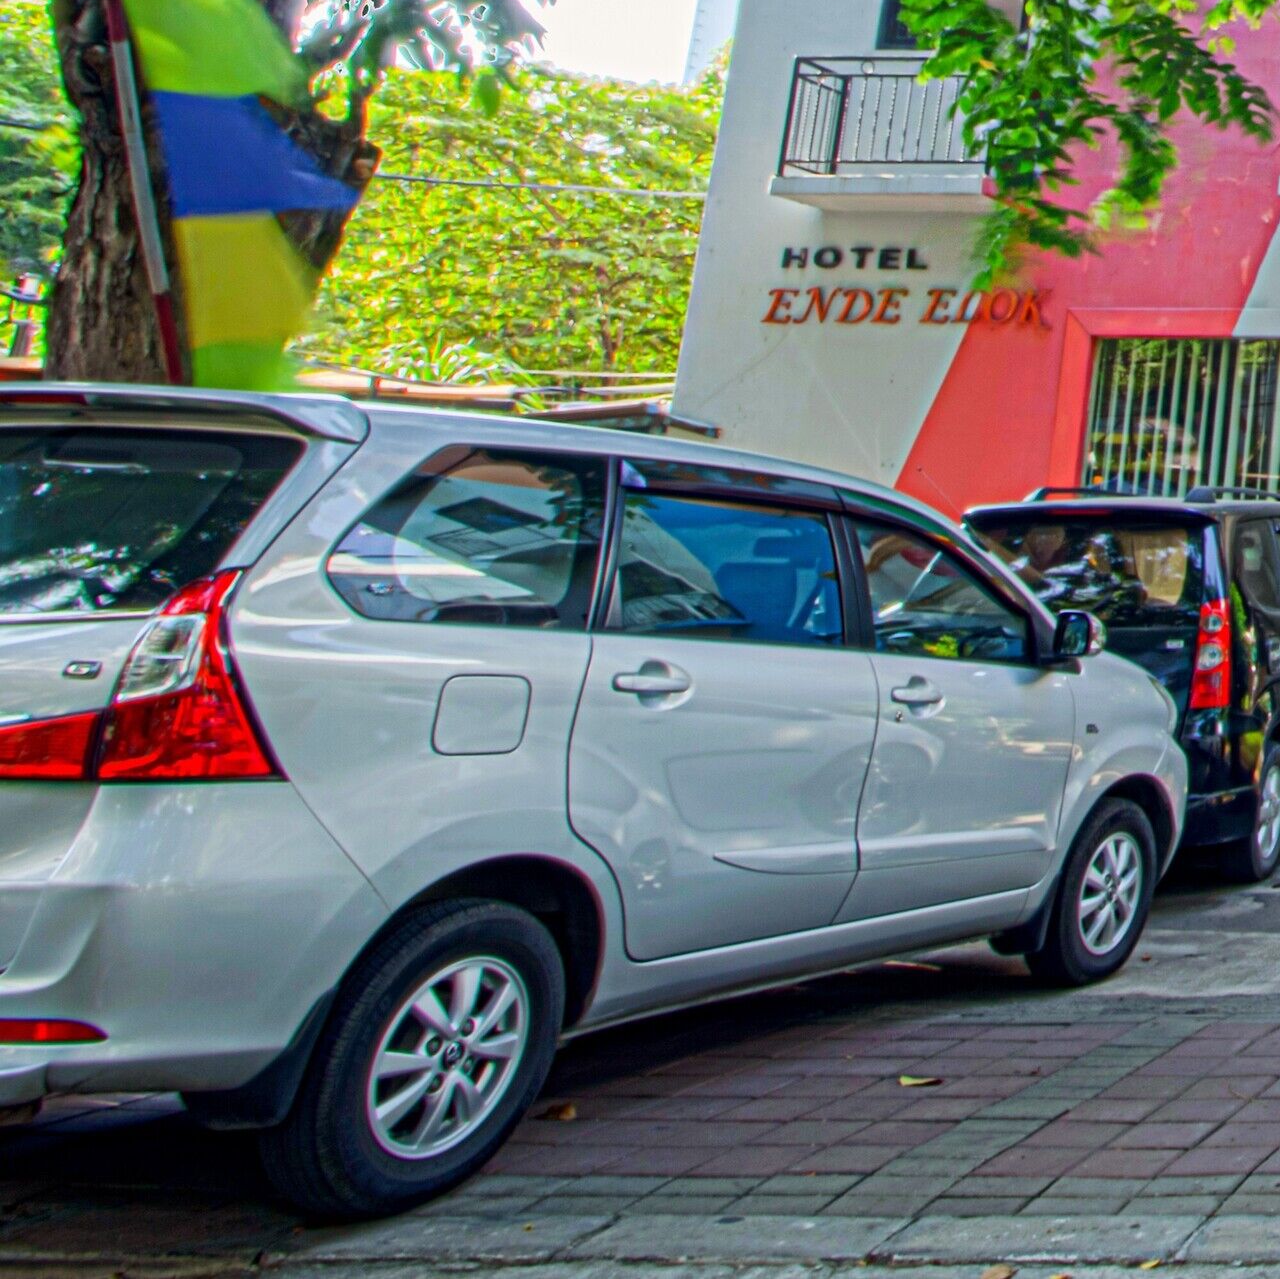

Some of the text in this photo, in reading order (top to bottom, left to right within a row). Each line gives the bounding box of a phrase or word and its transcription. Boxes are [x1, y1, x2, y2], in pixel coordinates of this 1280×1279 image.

[780, 246, 928, 270] HOTEL
[760, 286, 1053, 328] ENDE ELOK
